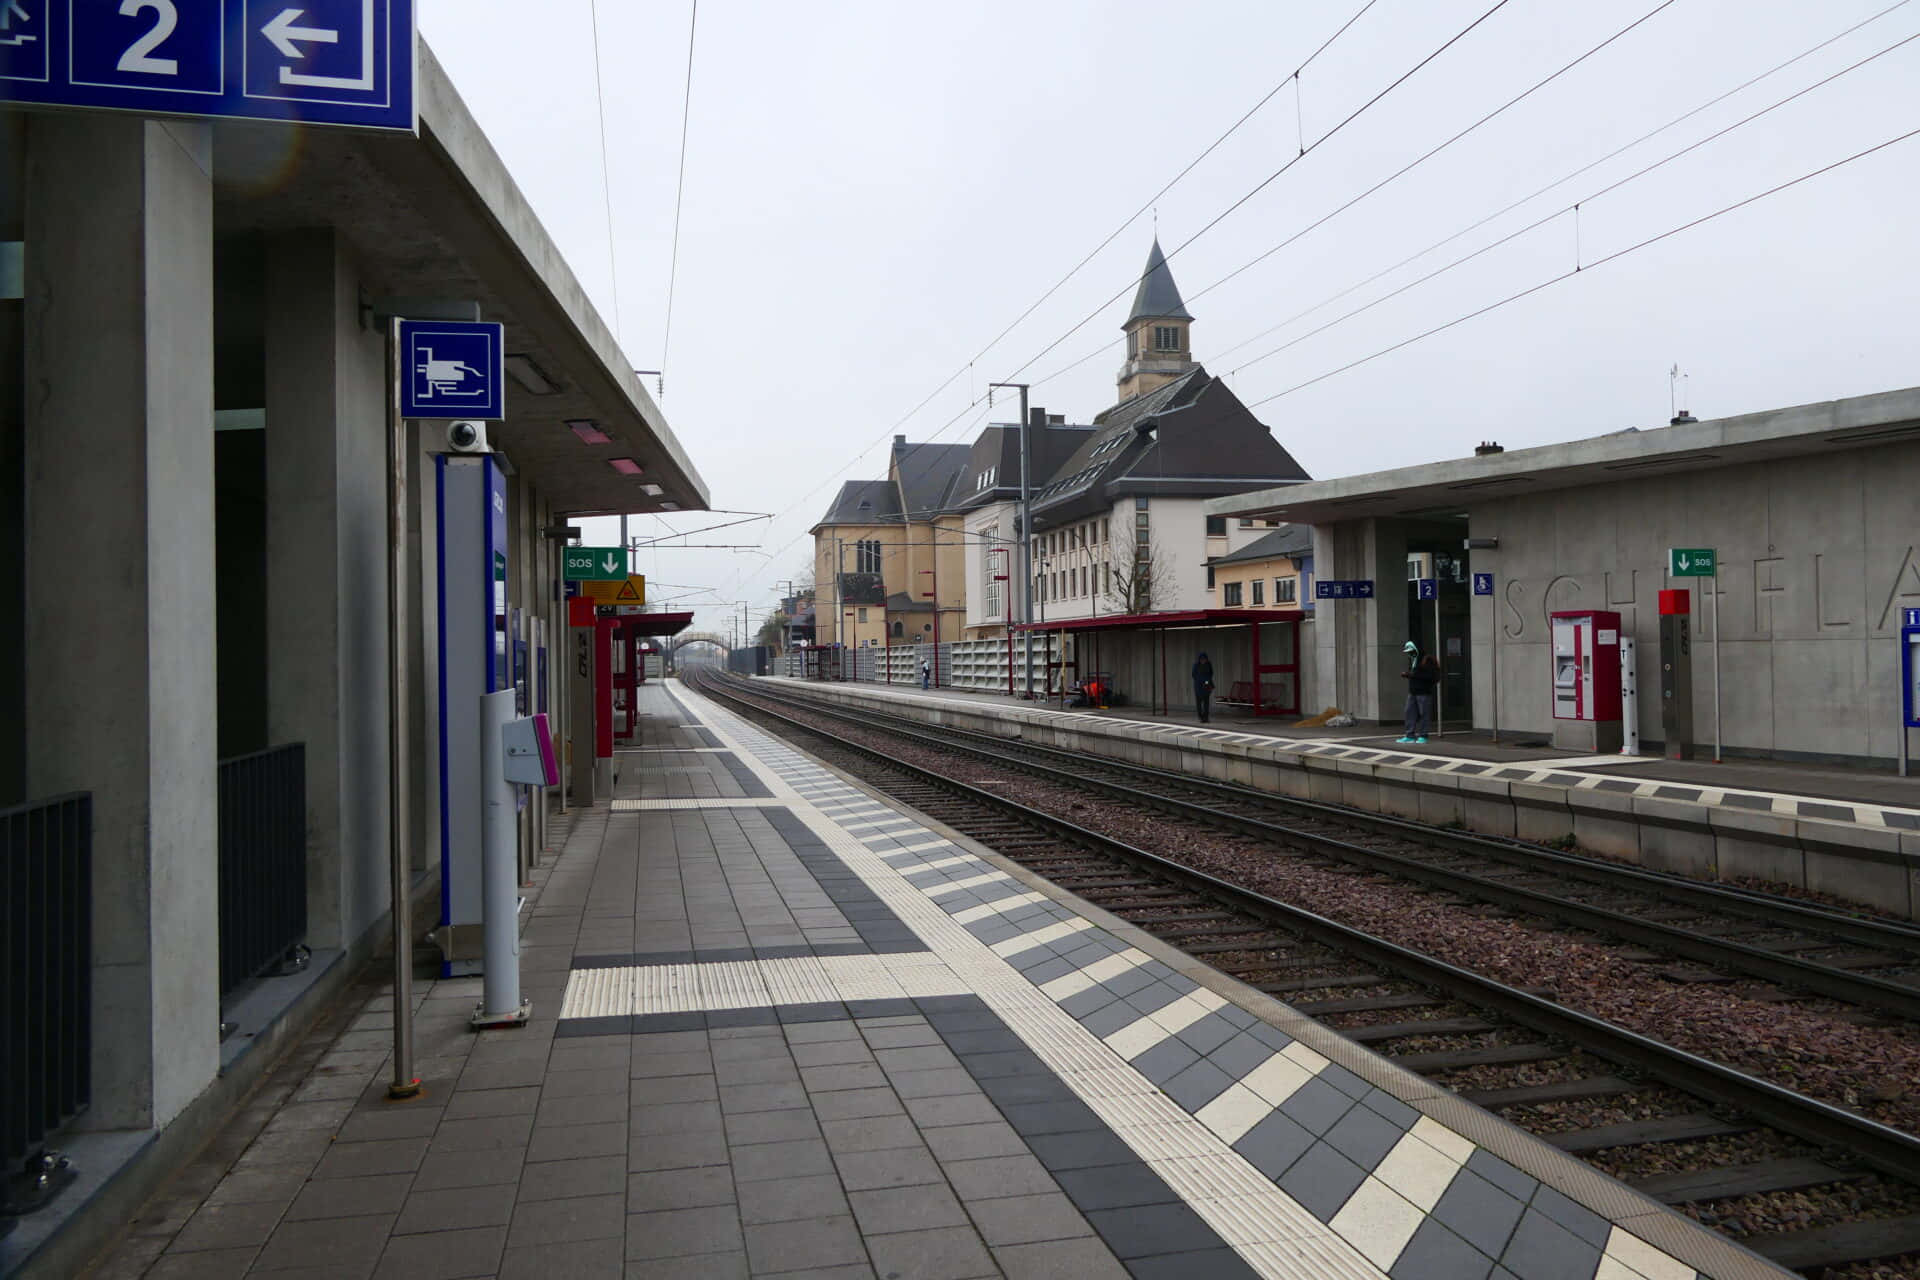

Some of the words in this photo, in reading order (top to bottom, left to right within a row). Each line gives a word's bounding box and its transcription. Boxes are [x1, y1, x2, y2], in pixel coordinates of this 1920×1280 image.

[116, 0, 178, 75] 2
[568, 559, 593, 568] SOS
[1695, 558, 1711, 566] SOS
[1425, 585, 1432, 596] 2
